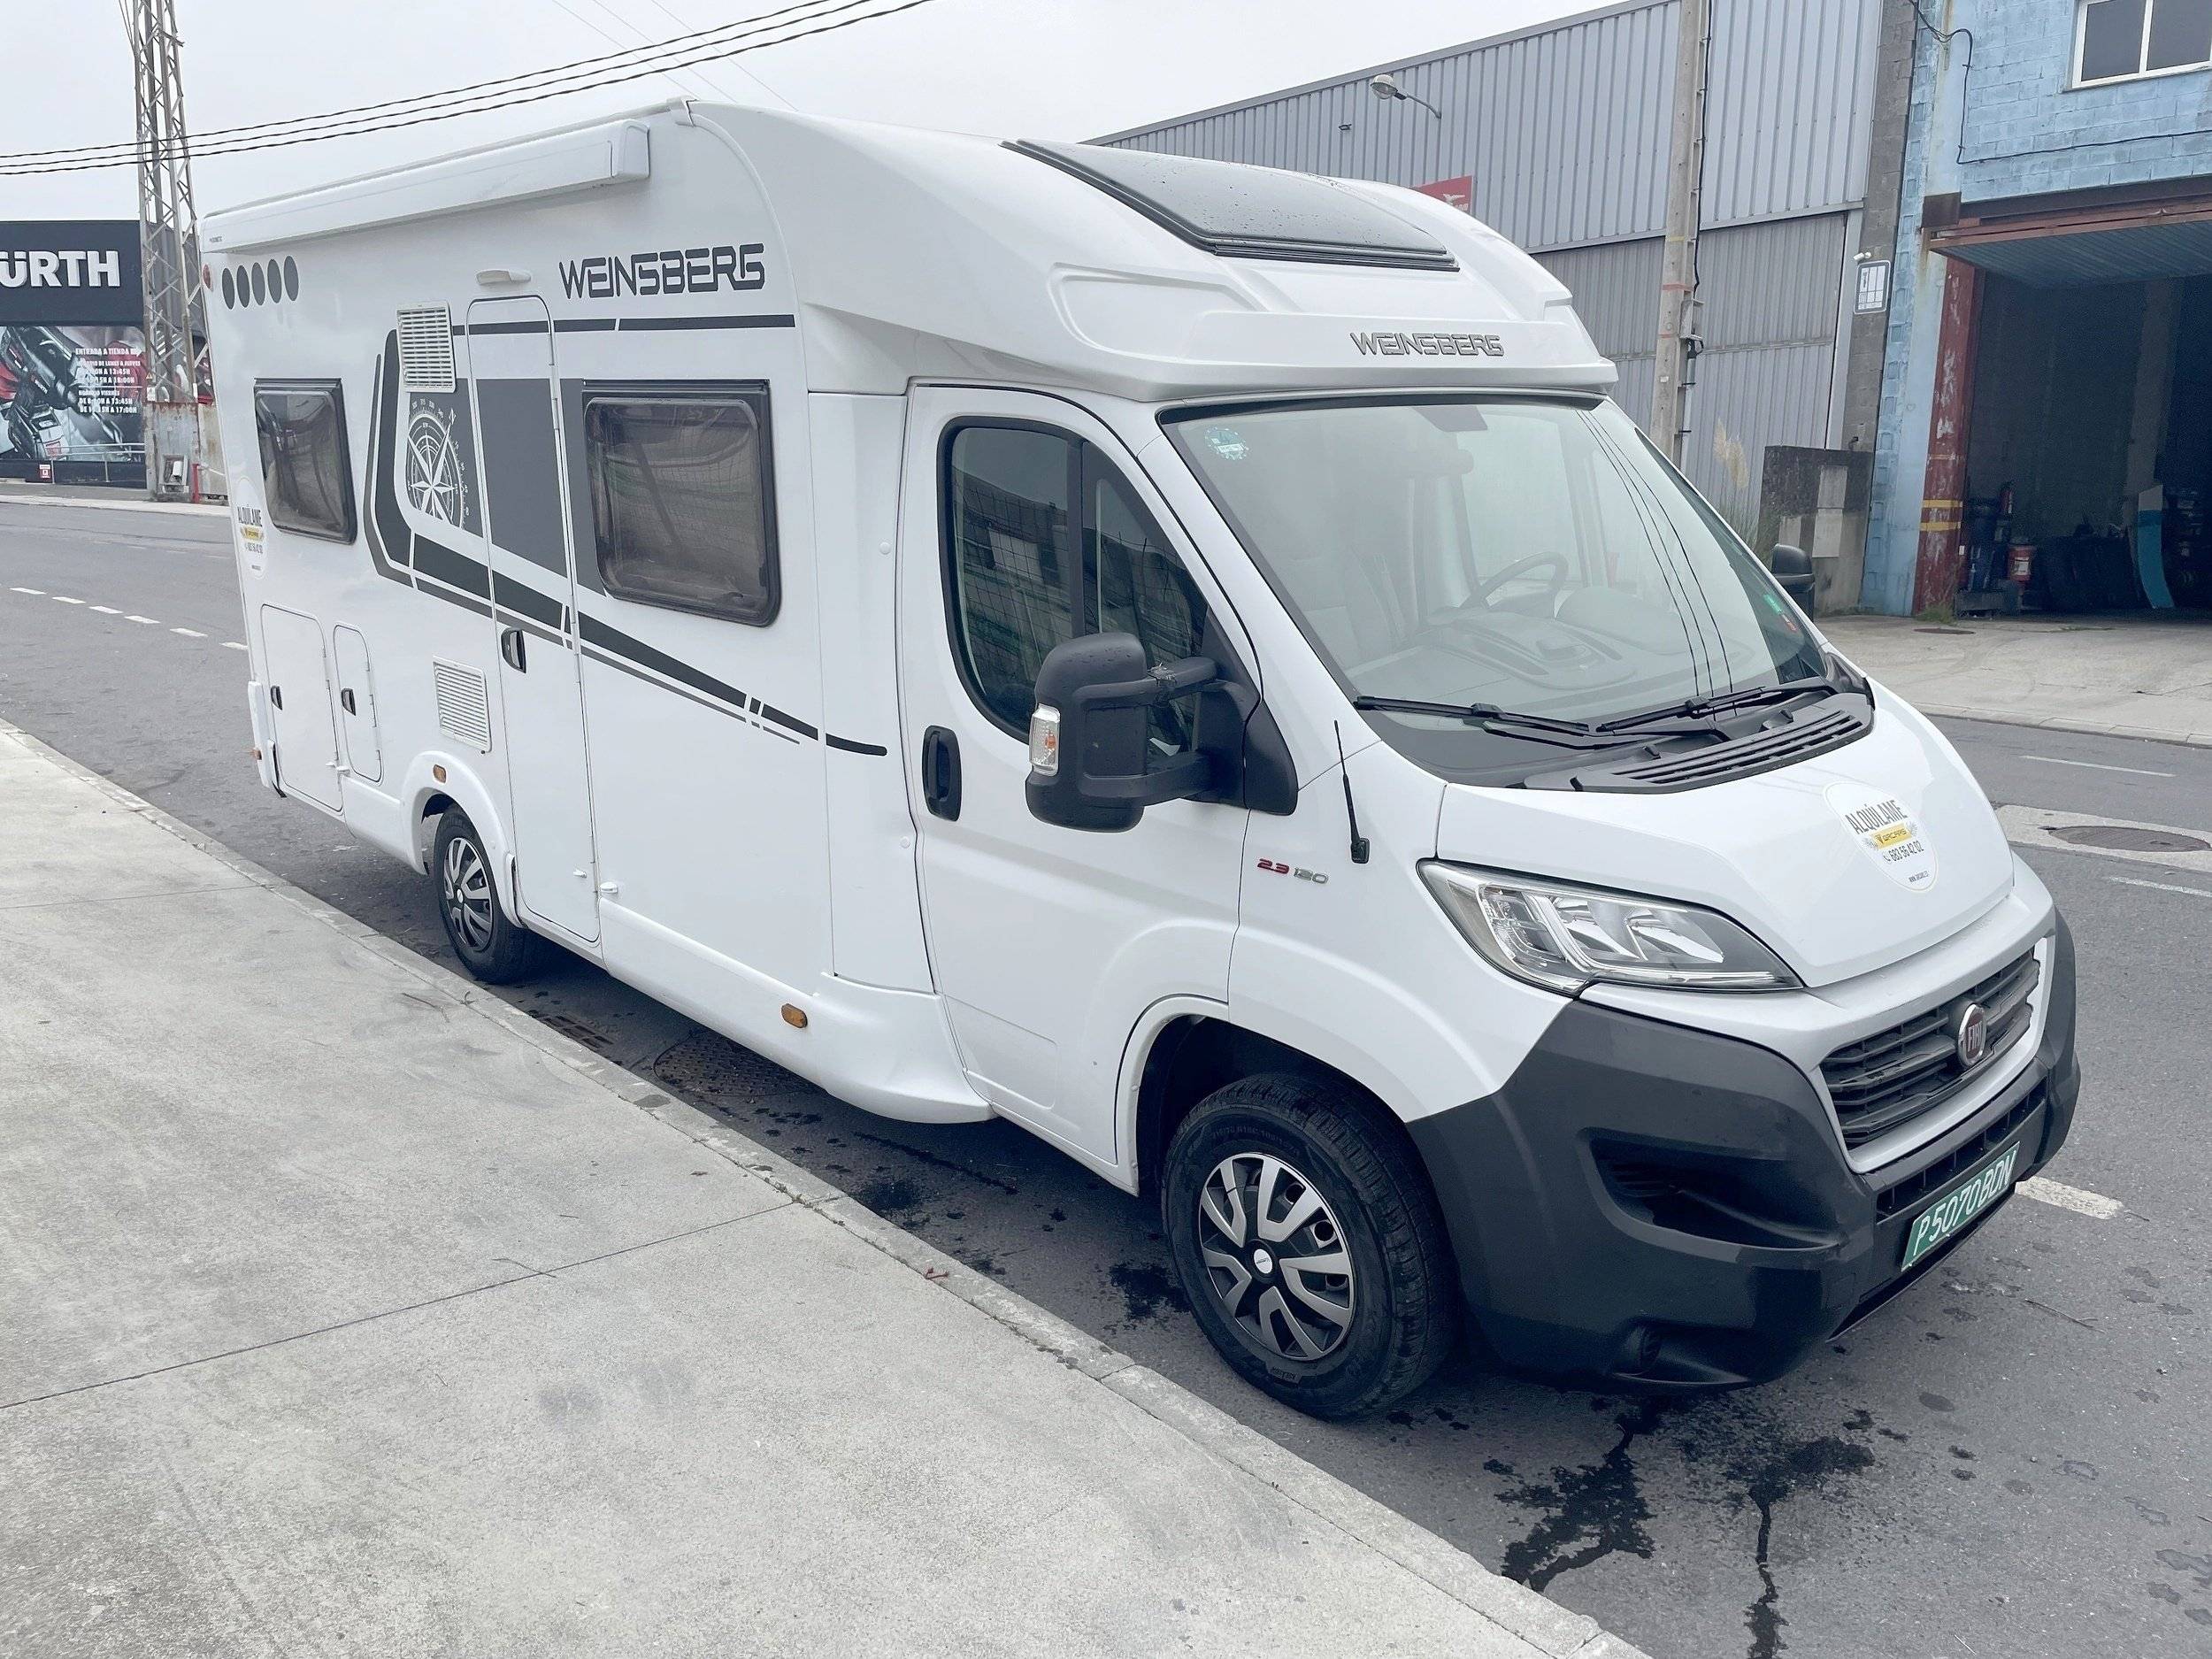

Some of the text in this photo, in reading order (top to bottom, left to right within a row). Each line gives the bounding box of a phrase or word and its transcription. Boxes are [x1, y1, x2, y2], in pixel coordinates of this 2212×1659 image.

[559, 242, 765, 300] WEINSBERG
[1349, 332, 1504, 357] WEINSBERG
[1968, 1020, 1983, 1052] FIAT
